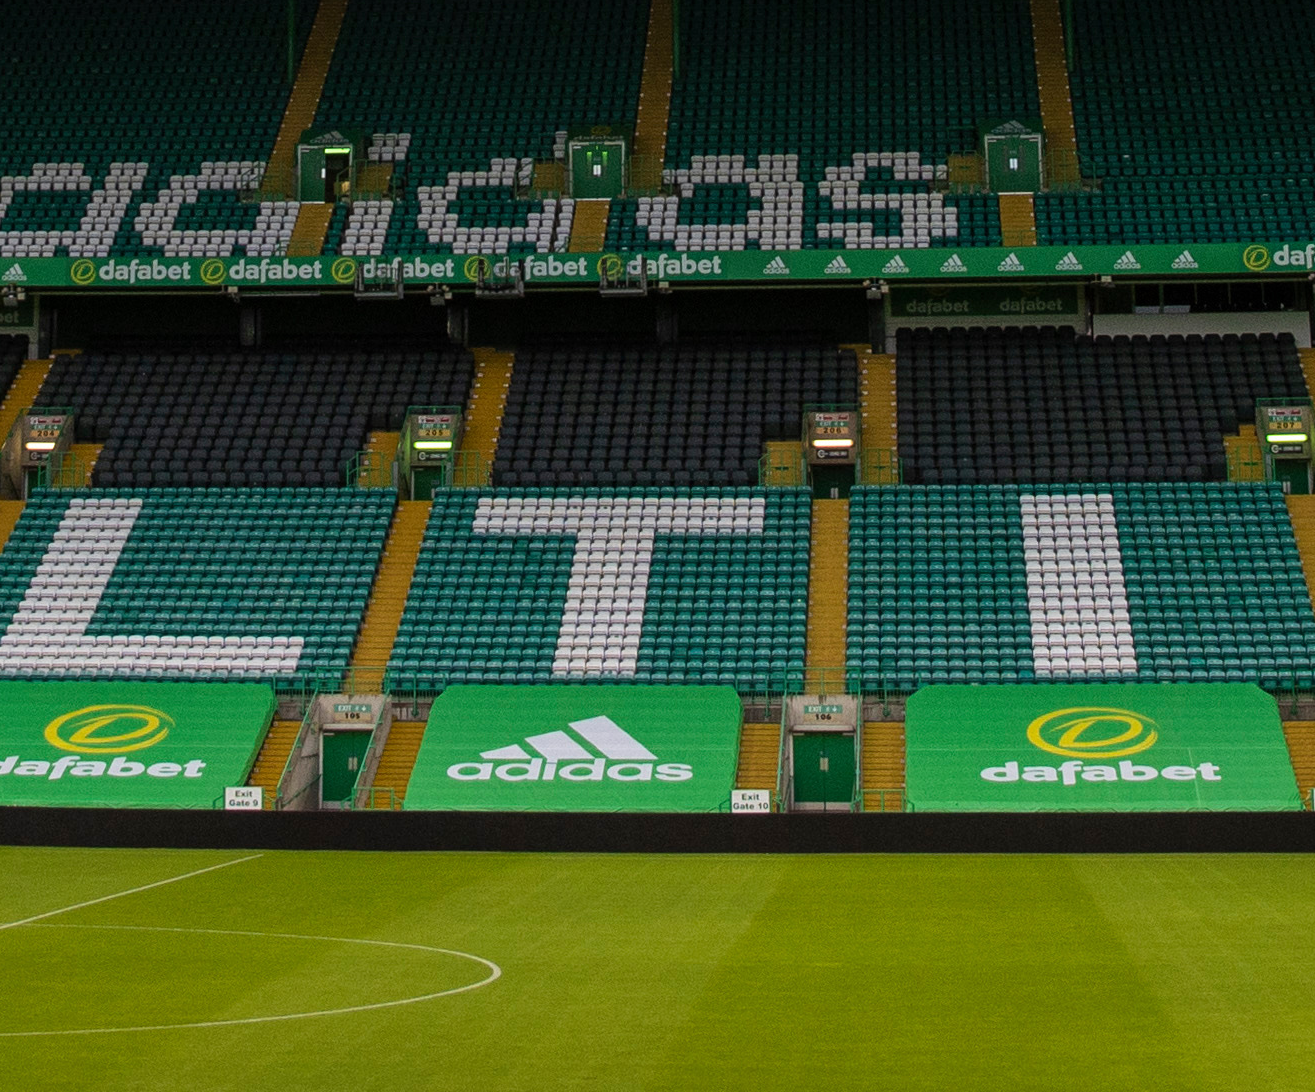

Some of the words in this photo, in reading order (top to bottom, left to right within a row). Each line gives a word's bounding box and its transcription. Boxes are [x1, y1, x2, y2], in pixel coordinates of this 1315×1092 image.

[99, 259, 191, 284] dafabet
[229, 258, 322, 284] dafabet
[364, 256, 454, 282] dafabet
[493, 255, 588, 281] dafabet
[626, 253, 722, 279] dafabet
[906, 298, 969, 314] dafabet
[999, 297, 1063, 313] dafabet
[446, 756, 694, 782] adidas
[979, 760, 1222, 787] dafabet
[235, 790, 252, 798] Exit
